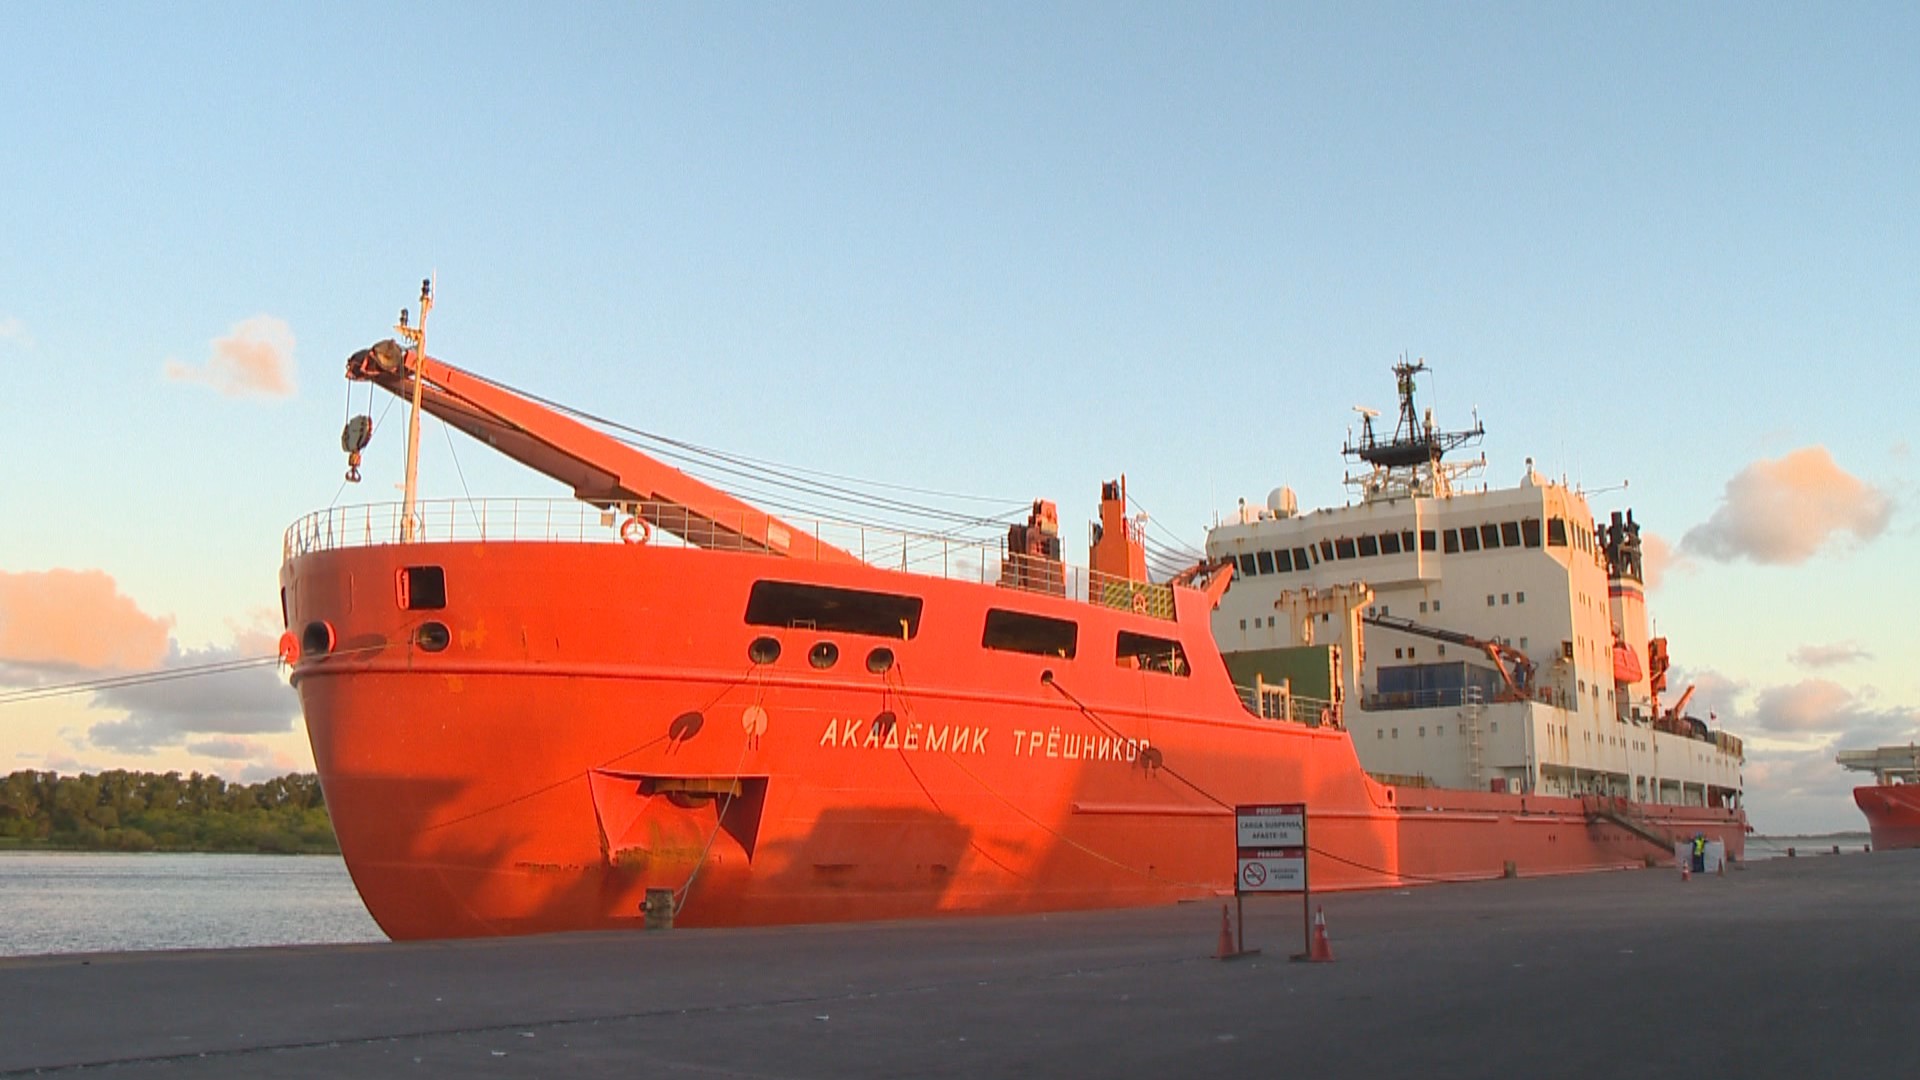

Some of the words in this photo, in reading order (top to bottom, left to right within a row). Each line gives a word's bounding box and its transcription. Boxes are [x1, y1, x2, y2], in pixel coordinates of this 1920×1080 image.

[820, 717, 990, 755] АКАДЕМИК
[1240, 821, 1263, 829] CARGA
[1265, 821, 1299, 829] SUSPENSA
